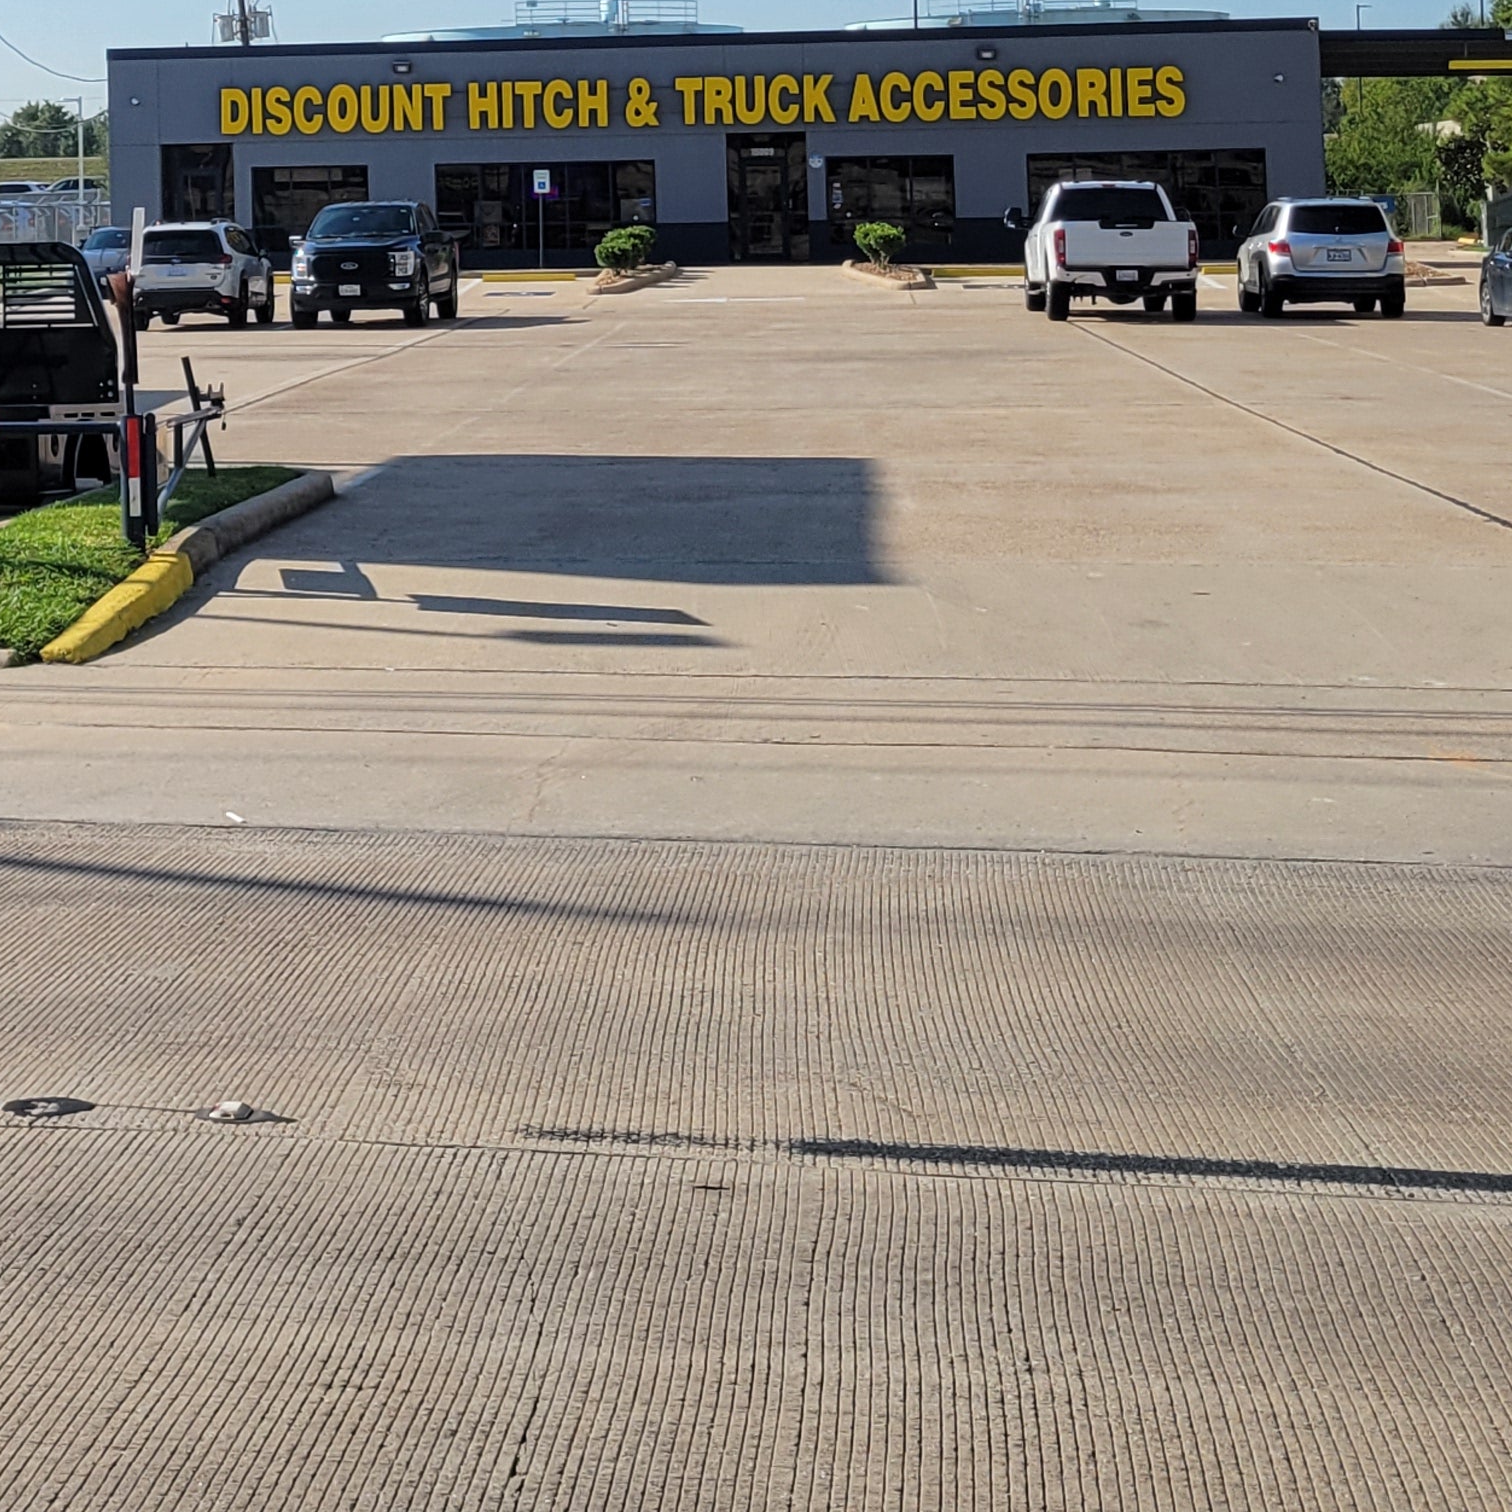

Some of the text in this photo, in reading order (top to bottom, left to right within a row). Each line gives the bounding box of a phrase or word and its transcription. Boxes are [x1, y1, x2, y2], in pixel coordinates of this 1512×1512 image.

[220, 66, 1186, 136] DISCOUNT HITCH & TRUCK ACCESSORIES
